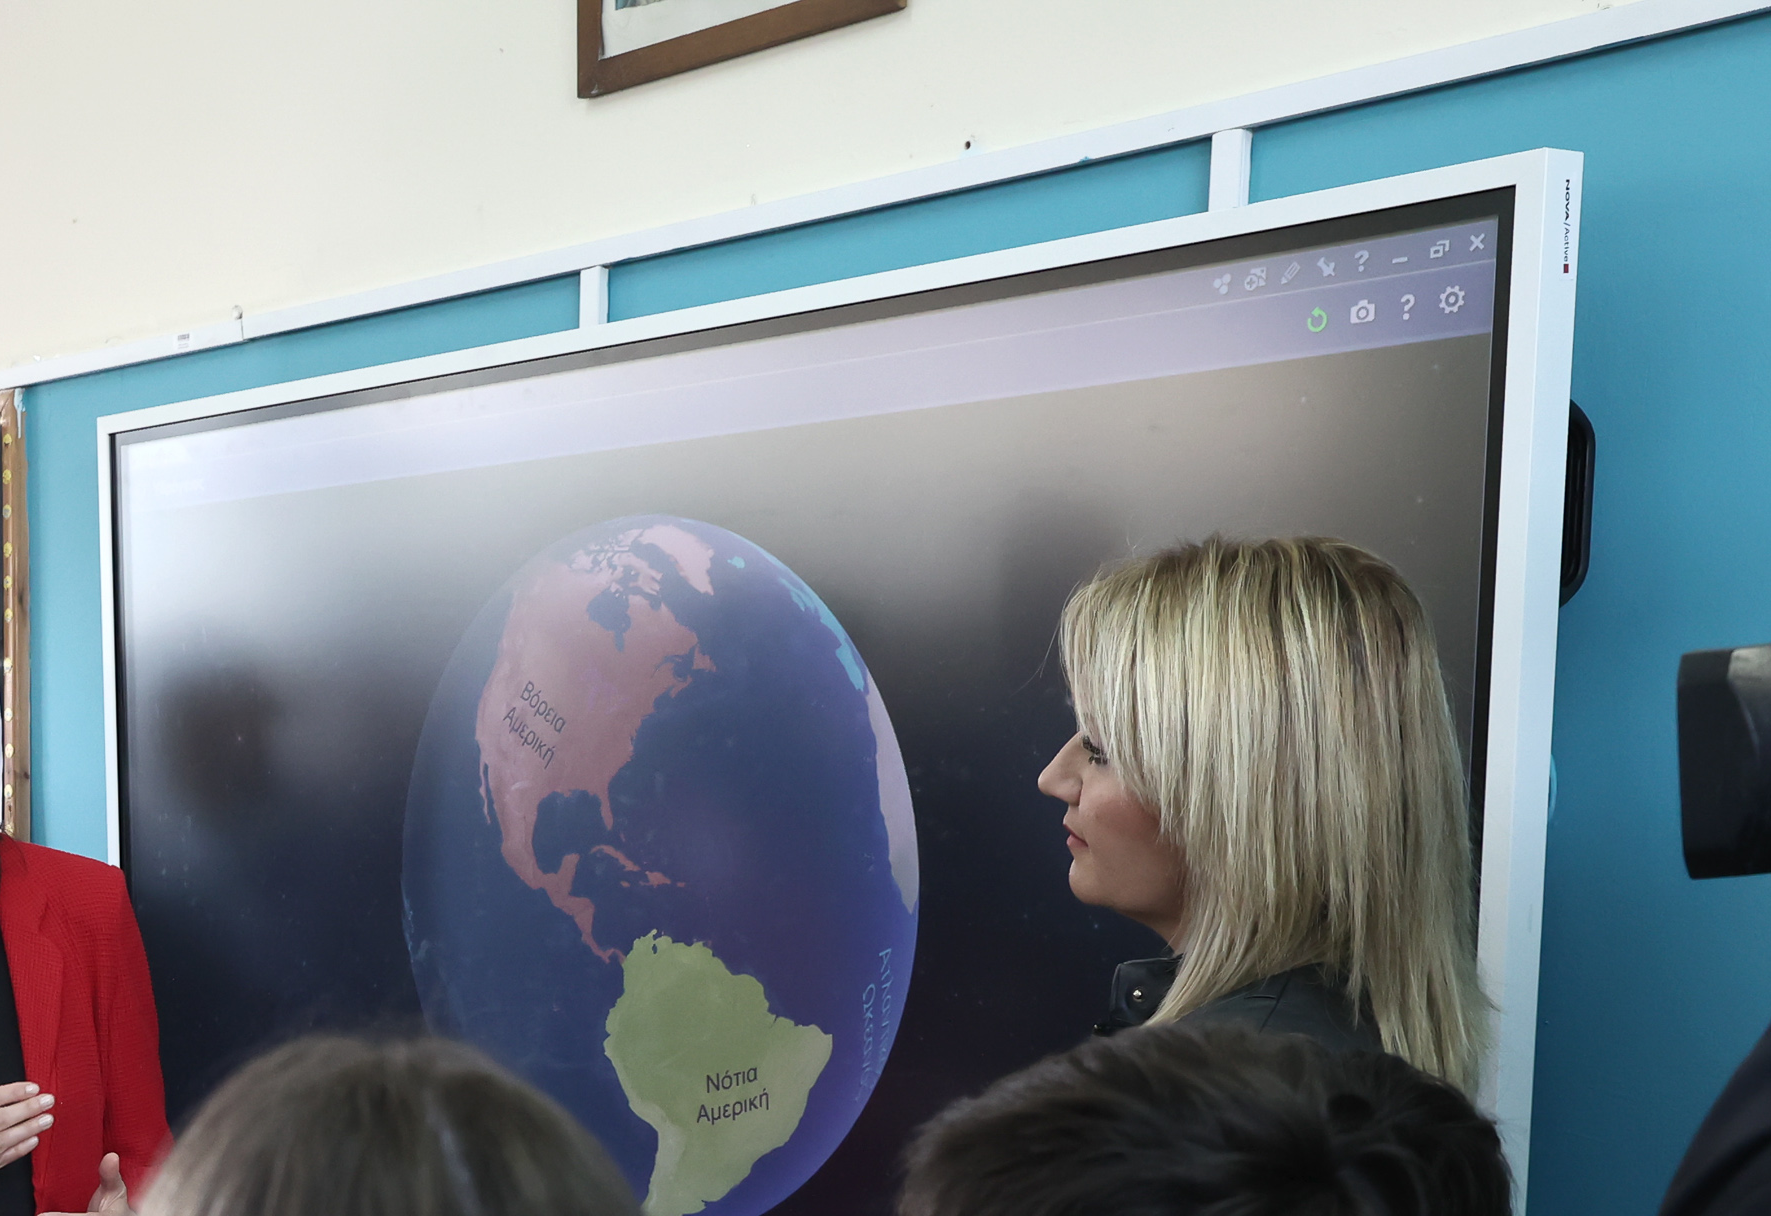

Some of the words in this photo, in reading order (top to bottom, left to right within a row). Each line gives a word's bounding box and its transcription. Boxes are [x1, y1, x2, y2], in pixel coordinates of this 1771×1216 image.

[520, 680, 566, 734] Βόρεια
[503, 706, 557, 770] Αμερική
[855, 983, 878, 1102] Ωκεαν
[696, 1087, 769, 1126] Αμερική
[706, 1067, 758, 1094] Νότια
